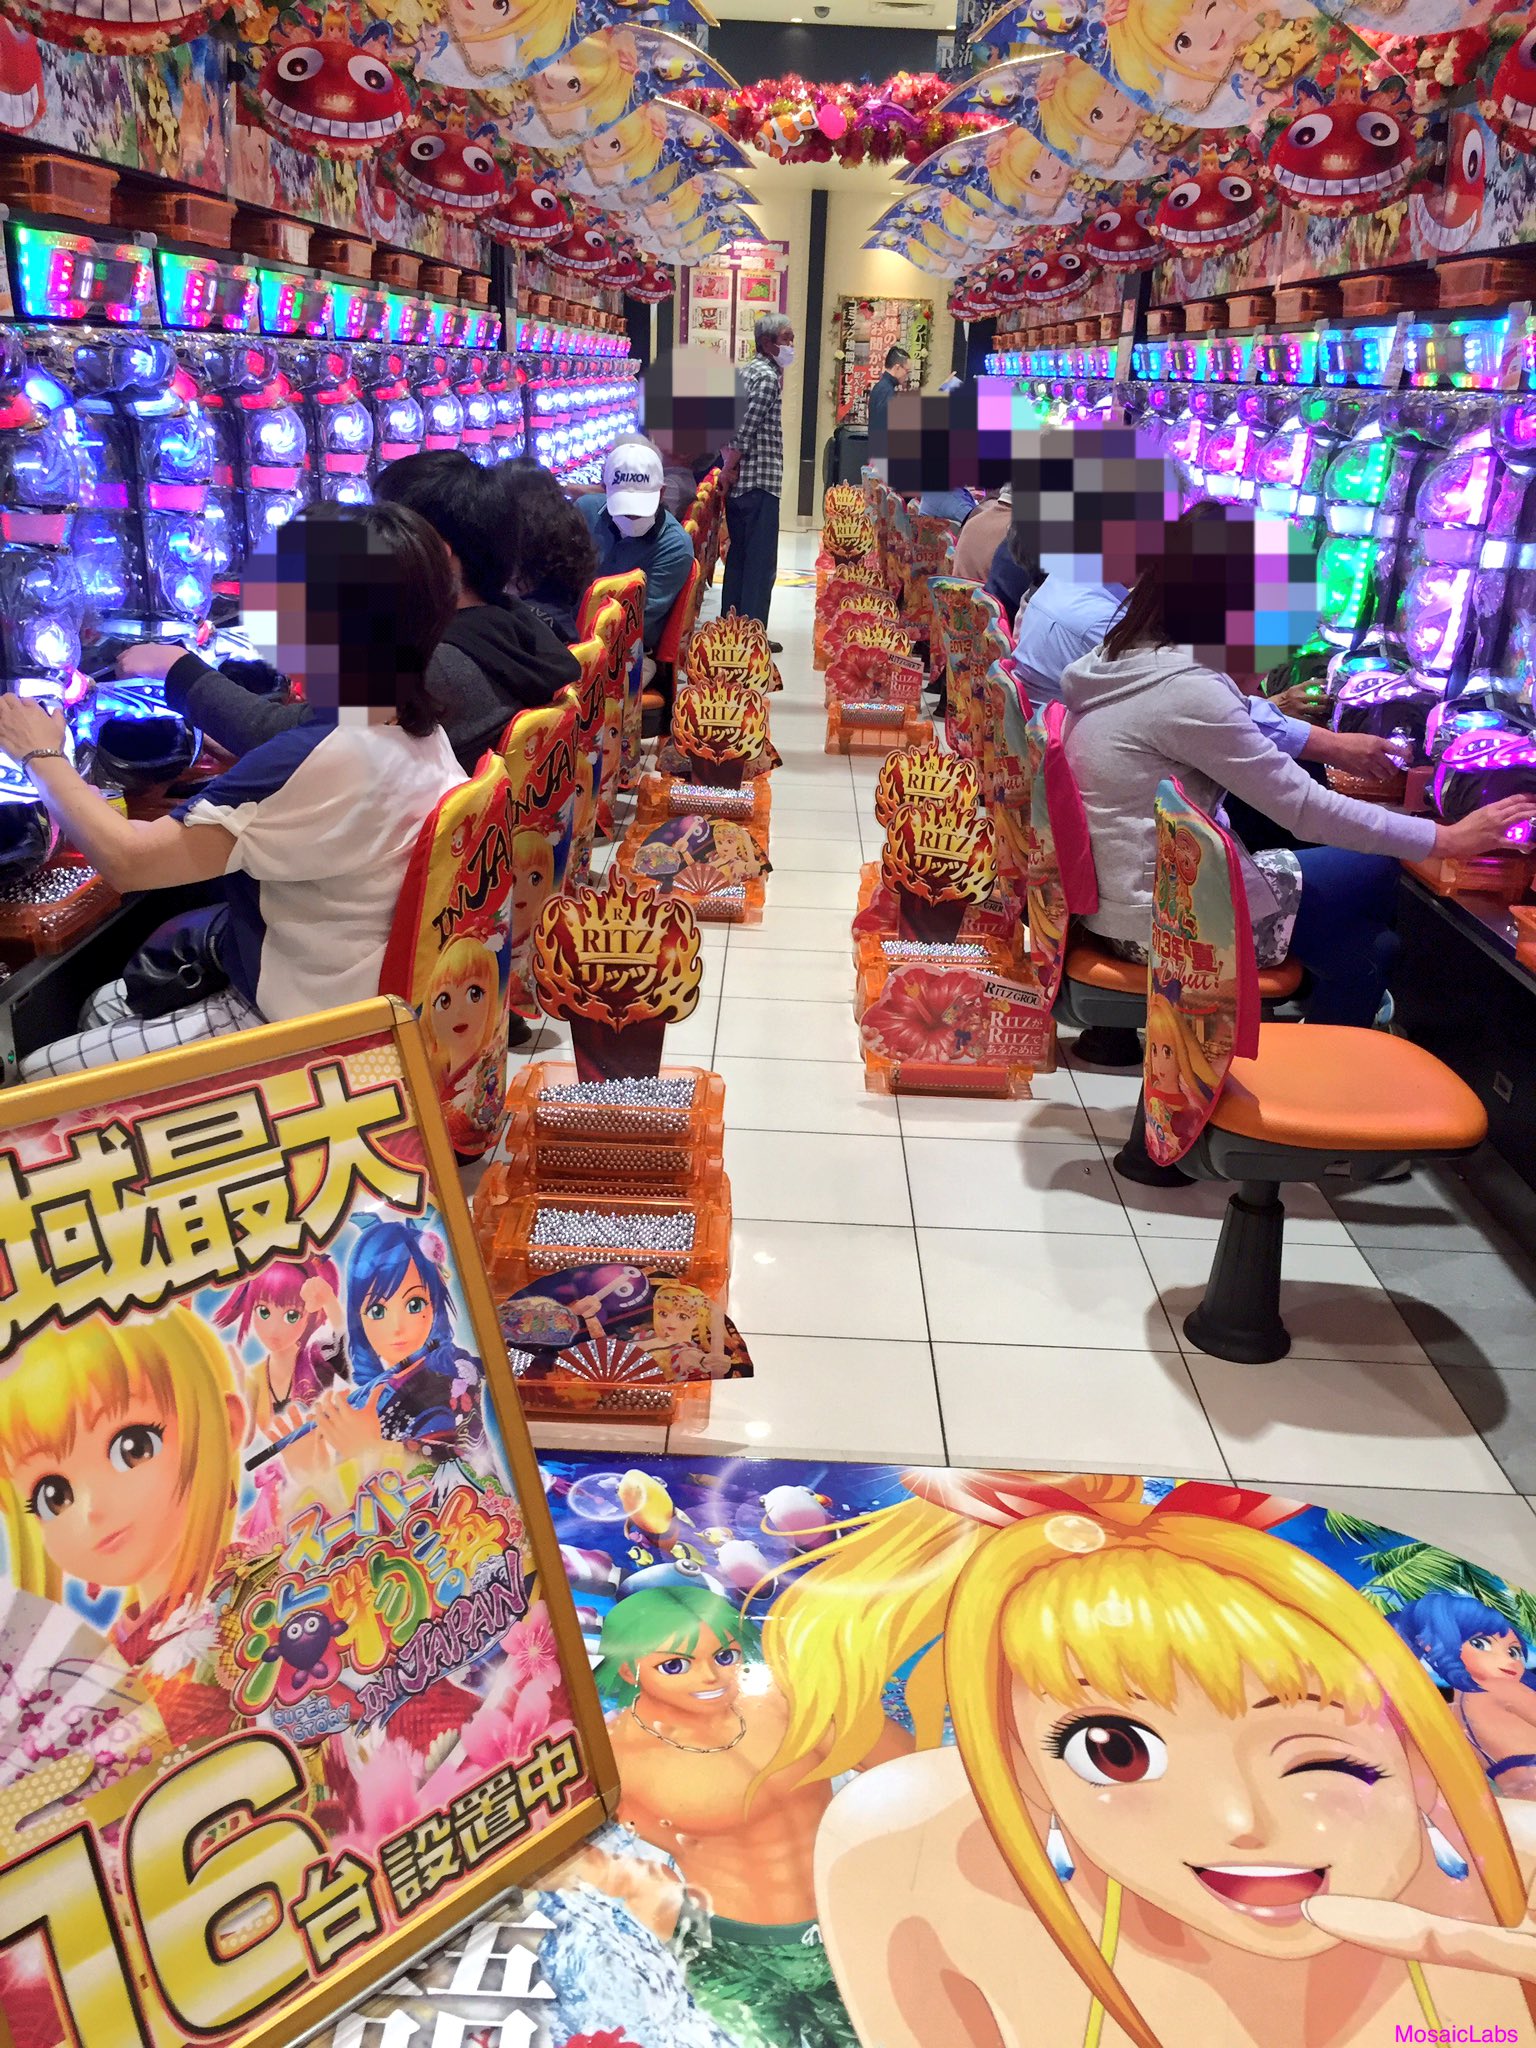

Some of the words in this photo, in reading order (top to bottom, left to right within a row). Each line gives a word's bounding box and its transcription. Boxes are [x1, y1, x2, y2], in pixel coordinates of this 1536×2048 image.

[612, 471, 650, 485] SRIXON
[711, 648, 748, 662] RITZ
[700, 705, 740, 721] RITZ
[698, 725, 741, 743] リッツ
[907, 773, 952, 793] RITZ
[919, 830, 971, 855] RITZ
[913, 854, 968, 881] リッツ
[613, 907, 623, 921] R
[581, 928, 656, 954] RITZ
[580, 964, 659, 993] リッツ
[986, 1044, 1041, 1056] あるために
[281, 1467, 433, 1572] スーパー
[357, 1667, 397, 1722] IN
[399, 1548, 526, 1693] JAPAN
[272, 1695, 331, 1726] SUPER
[293, 1702, 351, 1741] STORY
